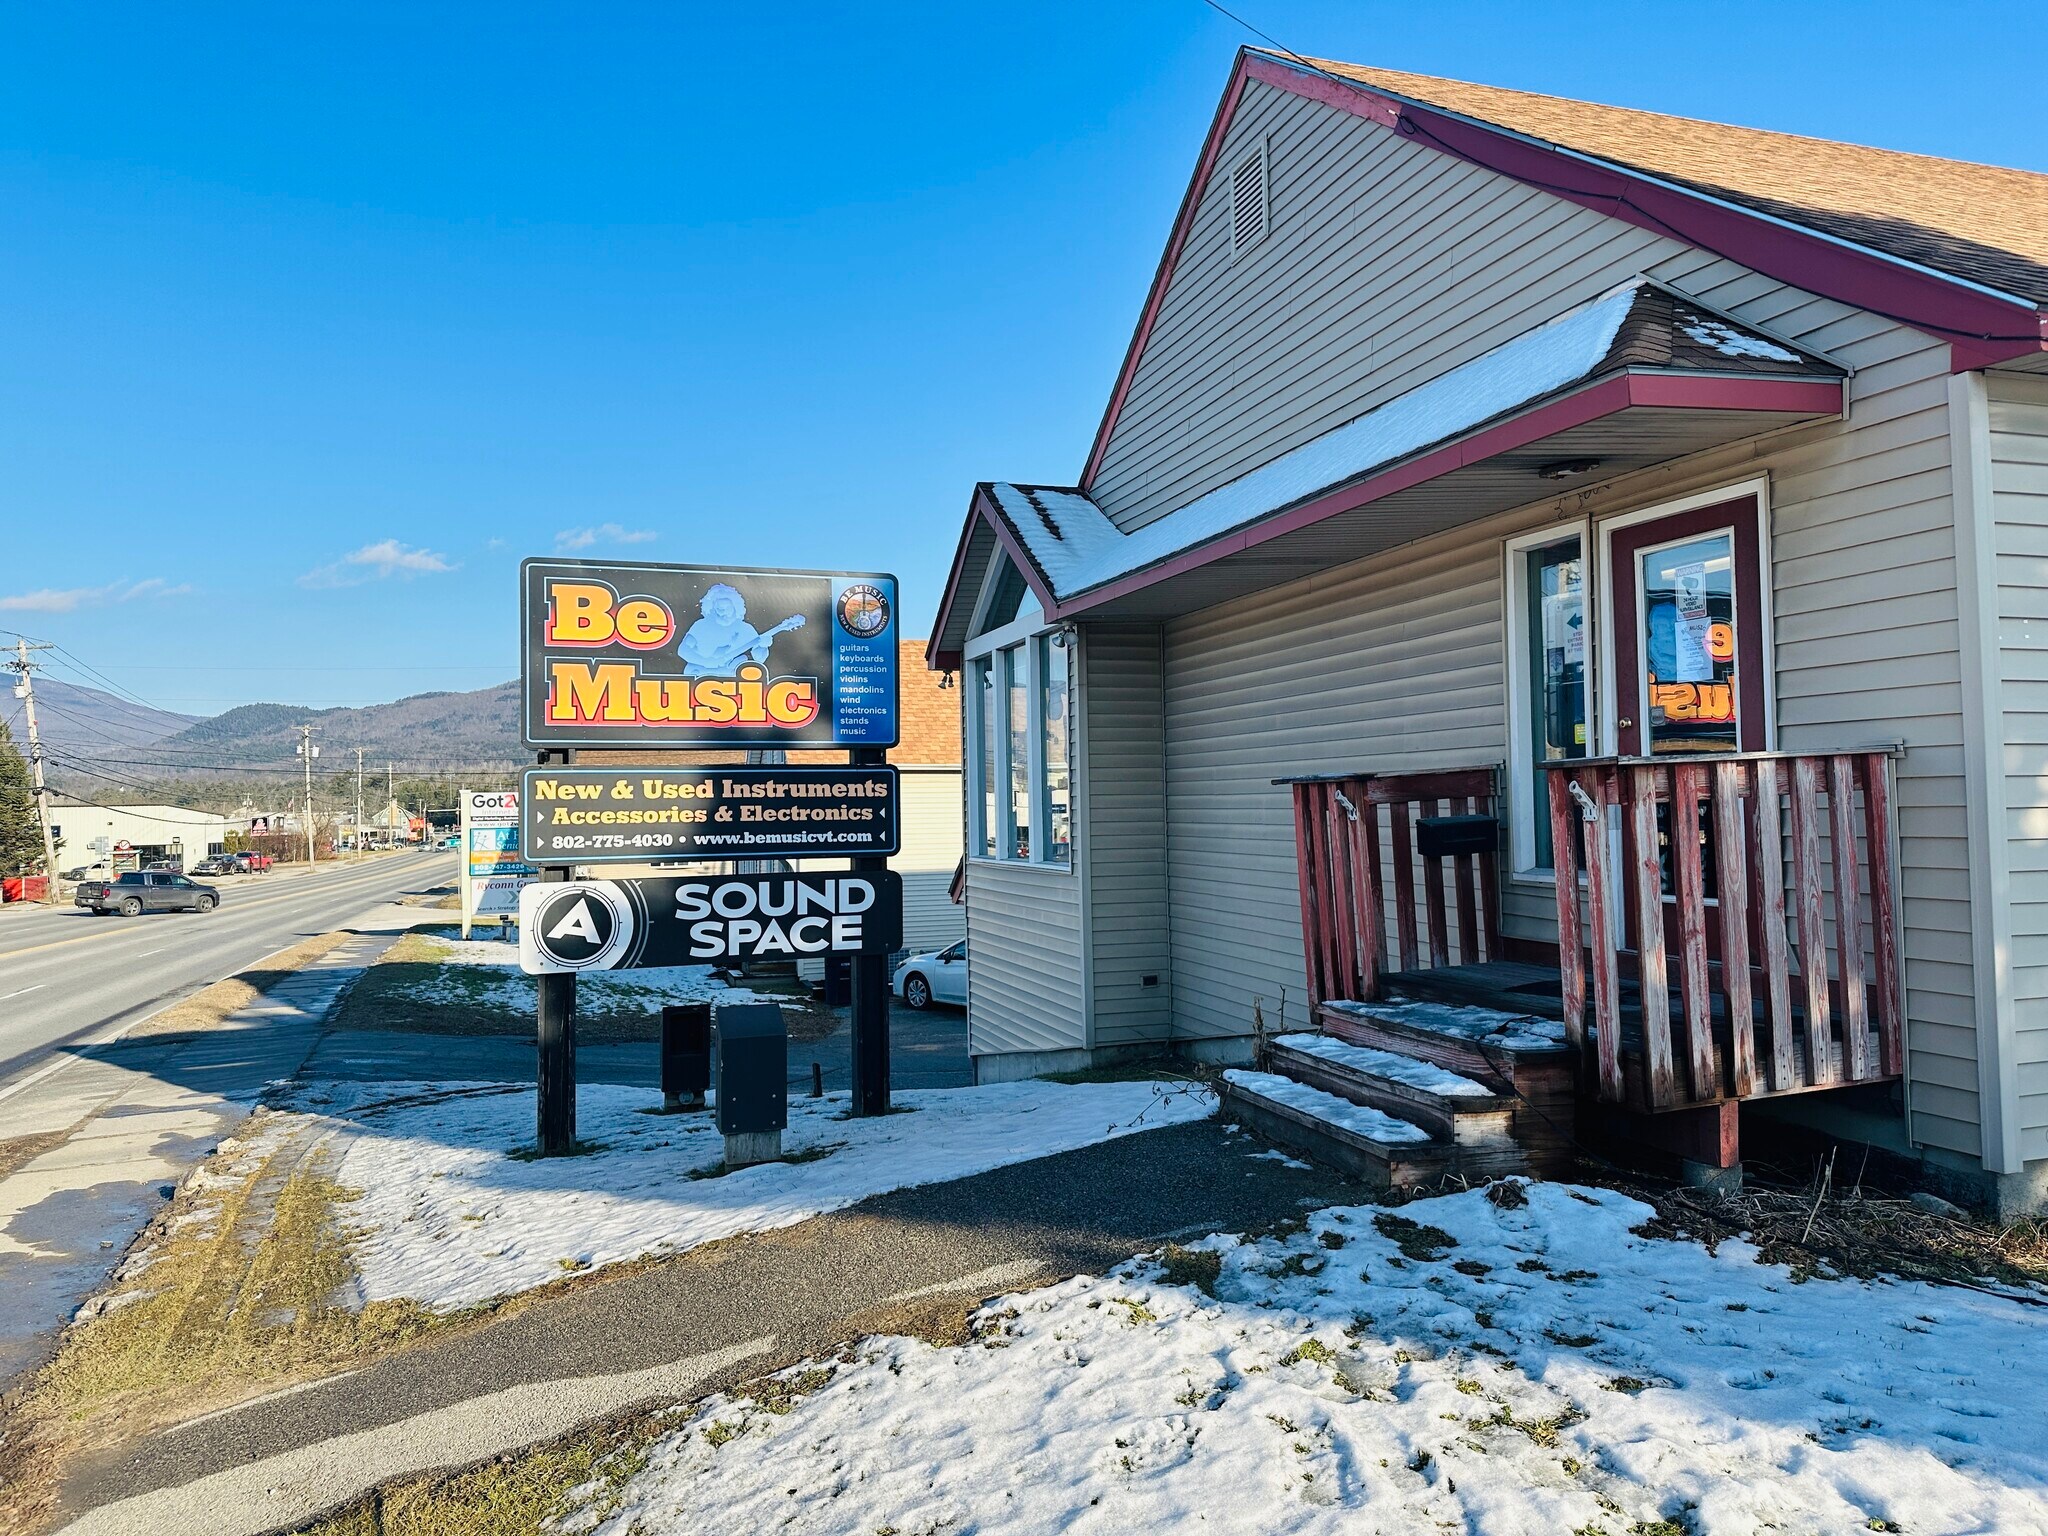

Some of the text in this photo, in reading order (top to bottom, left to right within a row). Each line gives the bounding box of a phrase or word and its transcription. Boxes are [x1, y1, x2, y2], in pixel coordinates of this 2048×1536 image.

[1676, 564, 1703, 576] WARNING
[840, 585, 887, 605] BE MUSIC
[546, 583, 675, 648] Be
[840, 644, 870, 654] guitars
[840, 654, 884, 664] keyboards
[840, 665, 887, 675] percussion
[840, 675, 868, 683] violins
[546, 662, 819, 727] Music
[840, 685, 884, 694] mandolins
[840, 696, 861, 704] wind
[840, 706, 887, 715] electronics
[840, 717, 869, 725] stands
[840, 727, 867, 735] music
[535, 779, 888, 800] New & Used Instruments
[552, 804, 873, 825] Accessories & Electronics
[497, 830, 509, 840] At
[552, 831, 873, 850] 802-775-4030 www.bemusicvt.com
[477, 881, 514, 891] Ryconn
[674, 878, 876, 920] SOUND
[546, 897, 602, 945] A
[689, 914, 863, 958] SPACE
